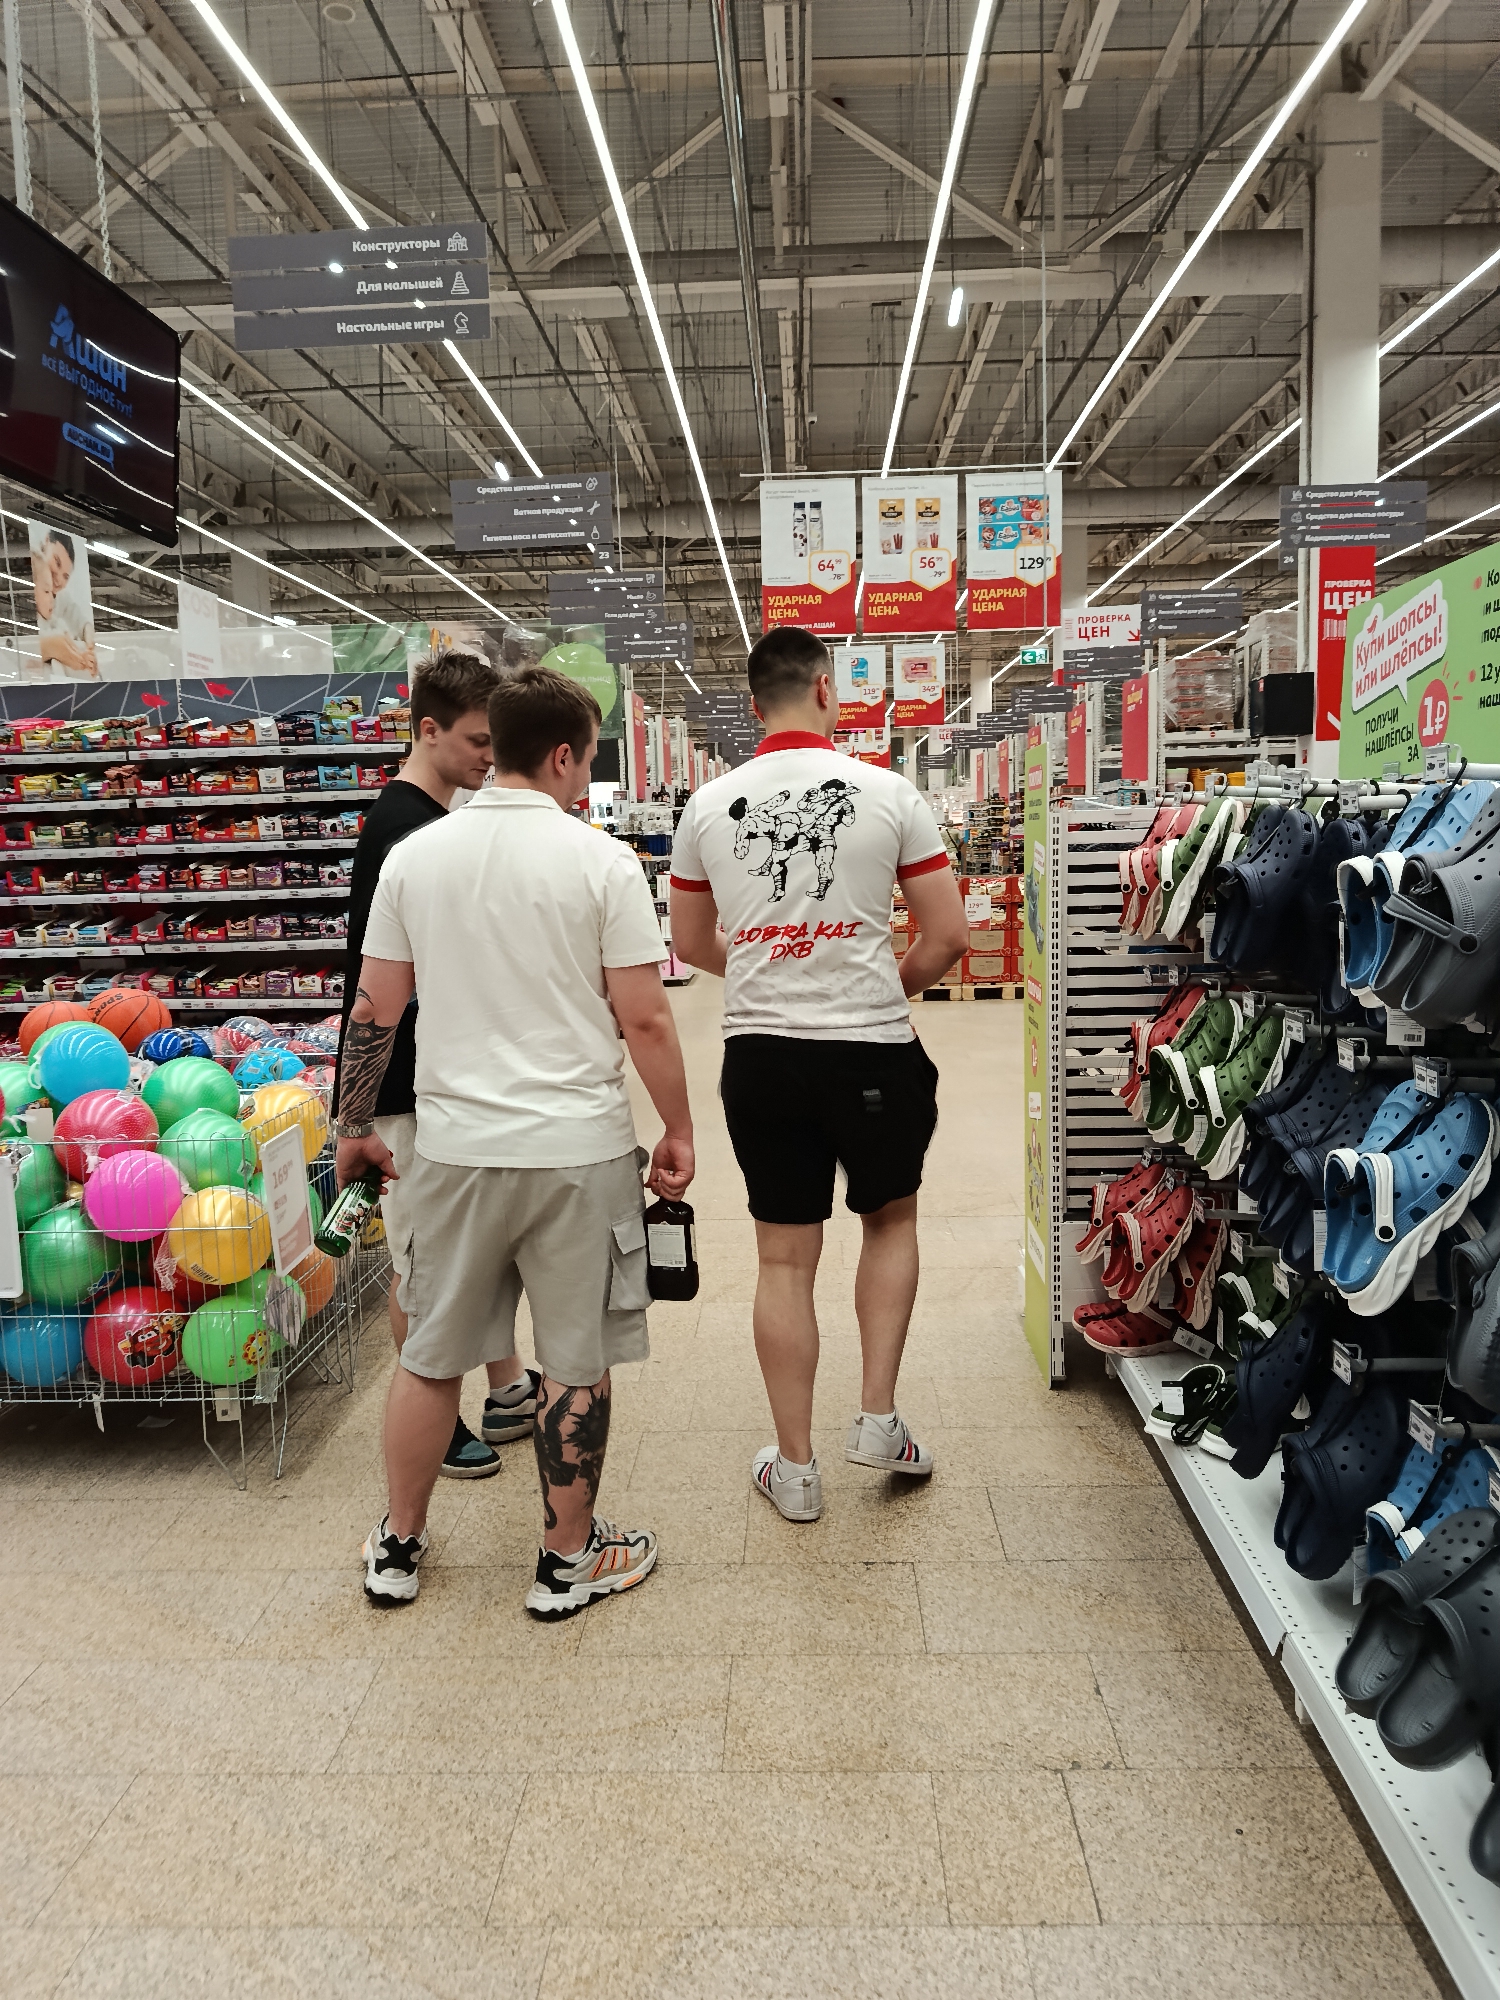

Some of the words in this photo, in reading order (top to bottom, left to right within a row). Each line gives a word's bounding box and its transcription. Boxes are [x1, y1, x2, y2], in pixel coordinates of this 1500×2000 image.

[352, 238, 440, 252] Конструкторы
[356, 281, 382, 295] Для
[384, 277, 443, 291] малышей
[336, 321, 412, 333] Настольные
[414, 319, 445, 331] игры
[598, 551, 610, 559] 23
[817, 559, 835, 572] 64
[919, 556, 936, 569] 56
[1019, 556, 1044, 570] 129
[1324, 579, 1372, 588] ПРОВЕРКА
[767, 594, 822, 608] УДАРНАЯ
[868, 592, 923, 605] УДАРНАЯ
[972, 588, 1027, 601] УДАРНАЯ
[972, 601, 1004, 614] ЦЕНА
[1323, 590, 1372, 614] ЦЕН
[767, 608, 799, 619] ЦЕНА
[868, 605, 900, 618] ЦЕНА
[1077, 613, 1131, 625] ПРОВЕРКА
[1078, 626, 1110, 642] ЦЕН
[1356, 632, 1385, 672] Купи
[1387, 593, 1437, 647] шопсы
[1355, 667, 1378, 699] или
[1380, 614, 1442, 682] шлёпсы!
[1480, 662, 1493, 682] 12
[897, 704, 927, 712] УДАРНАЯ
[897, 711, 914, 719] ЦЕНА
[1365, 706, 1399, 736] ПОЛУЧИ
[1365, 722, 1414, 758] НАШЛЁПСЫ
[1407, 743, 1419, 763] ЗА
[734, 921, 809, 946] COBRA
[813, 920, 864, 940] KAI
[769, 940, 815, 963] DXB
[272, 1166, 289, 1189] 169
